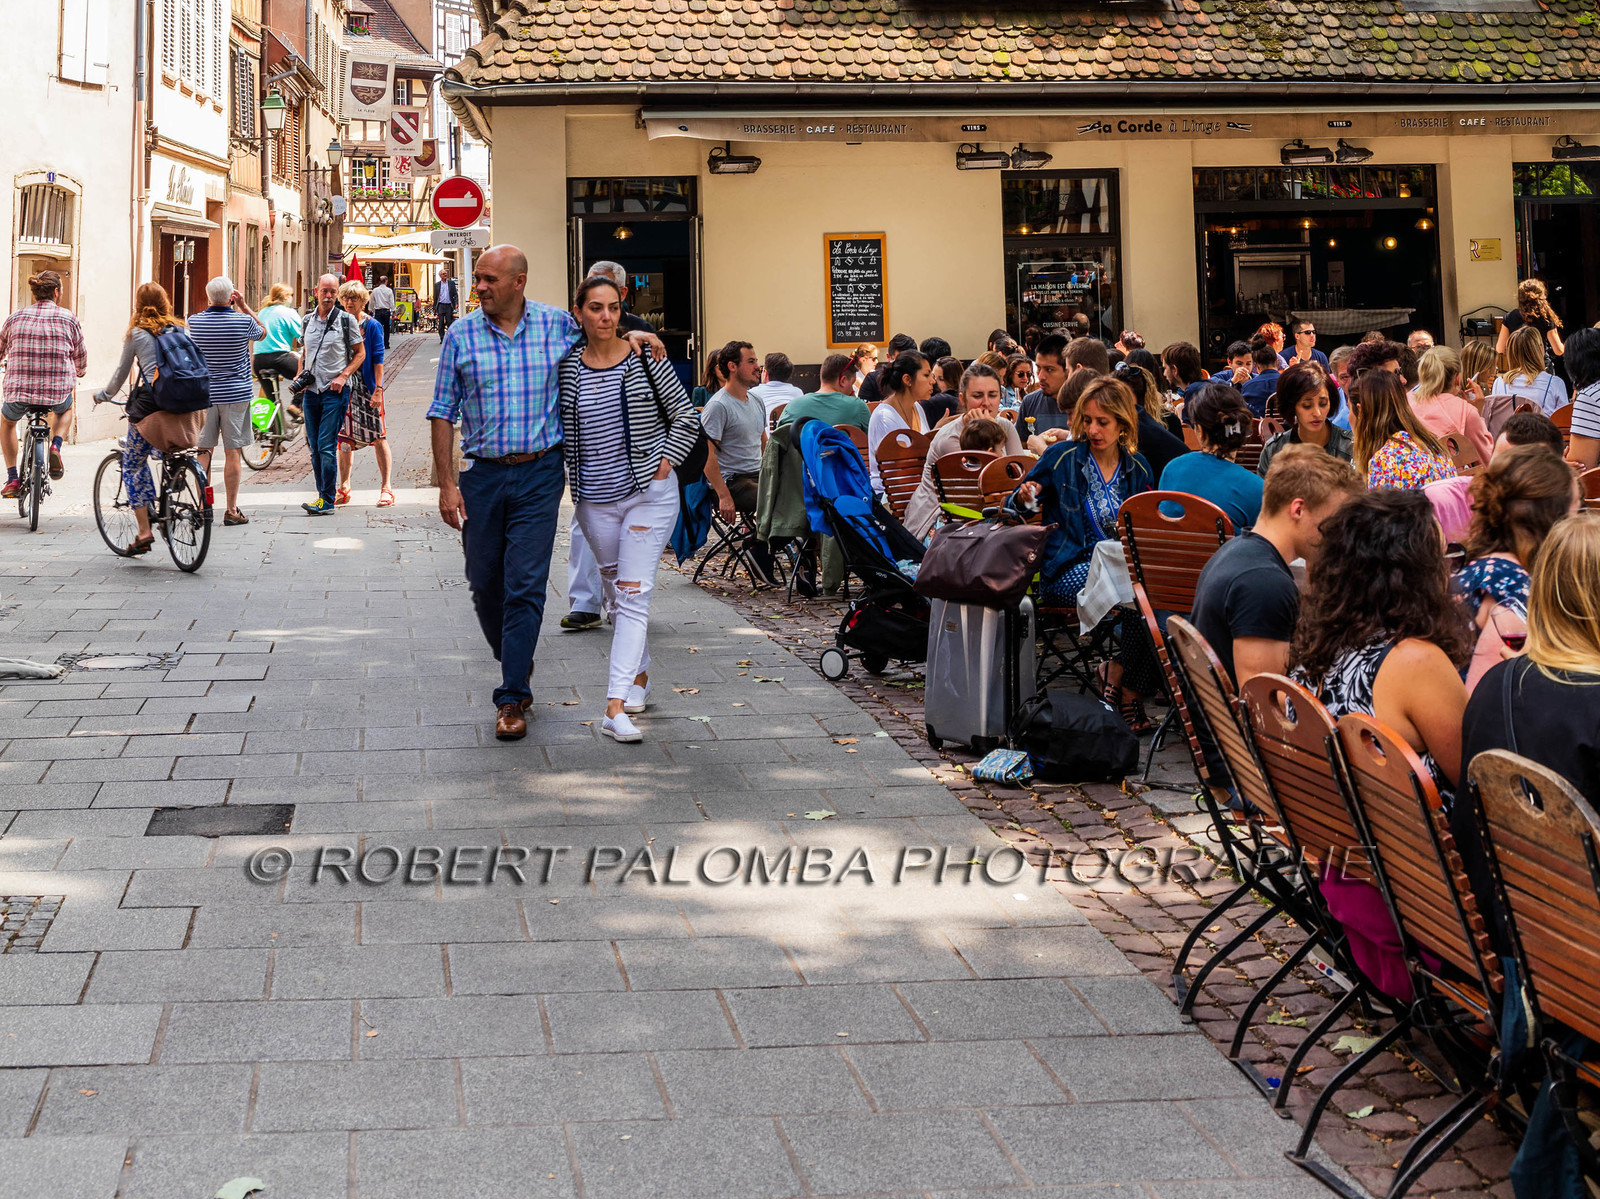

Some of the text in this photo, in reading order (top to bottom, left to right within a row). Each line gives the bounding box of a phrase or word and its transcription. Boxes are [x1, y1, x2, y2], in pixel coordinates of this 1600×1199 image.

[1117, 119, 1163, 133] Corde
[1168, 119, 1178, 133] à
[1182, 119, 1222, 135] Linge
[1400, 116, 1551, 128] BRASSERIE CAFÉ RESTAURANT
[743, 123, 907, 135] BRASSERIE CAFÉ RESTAURANT
[1057, 282, 1066, 290] EST
